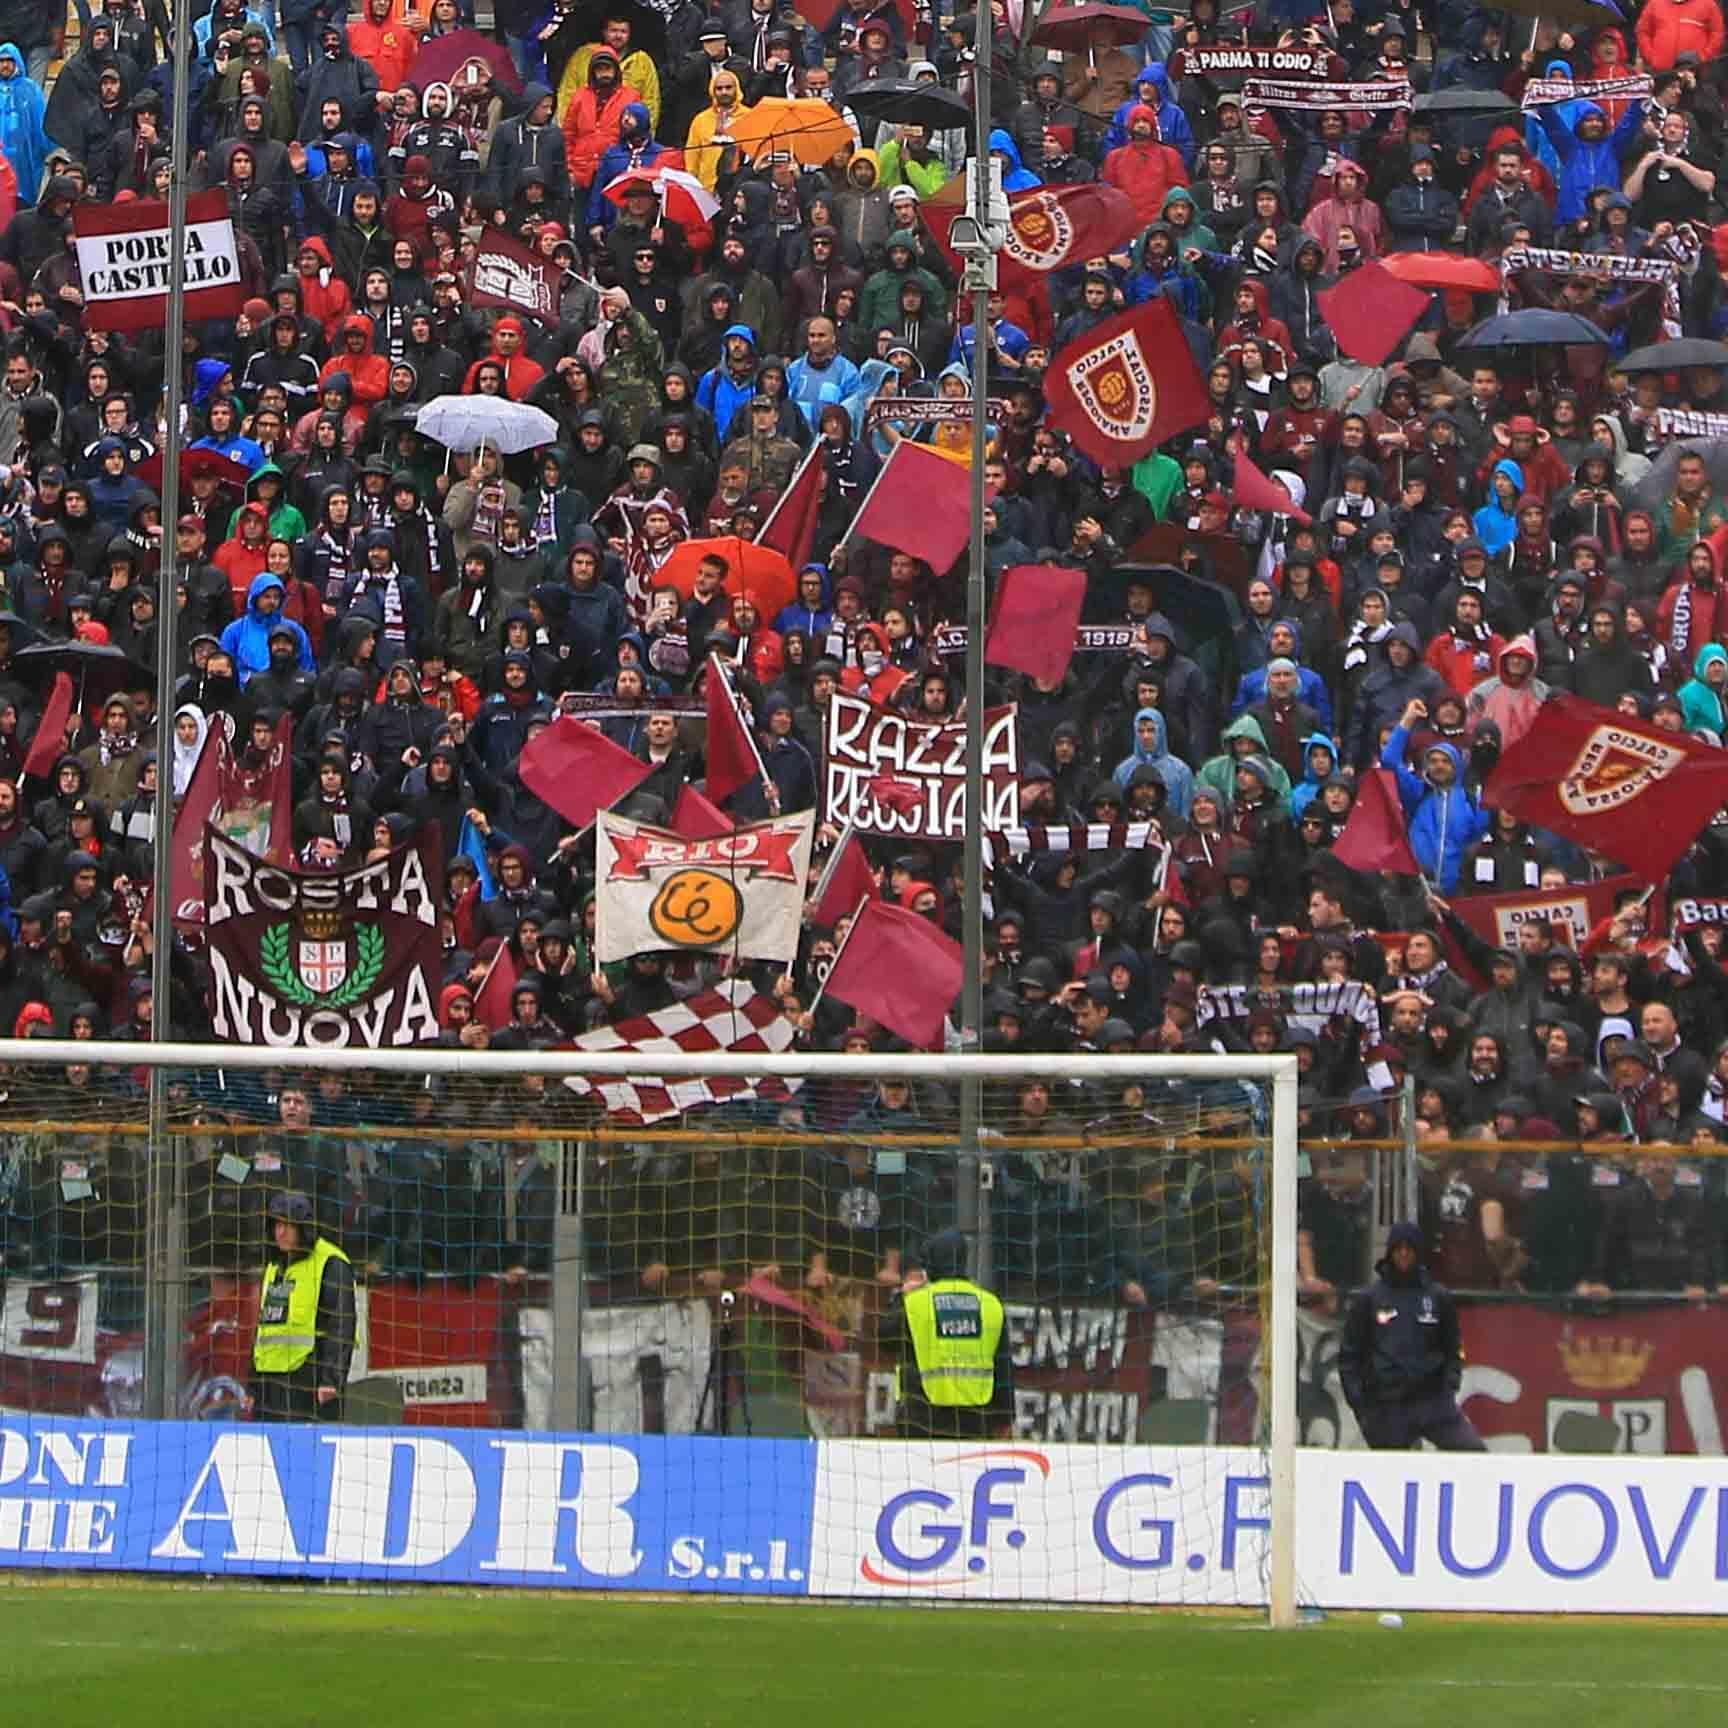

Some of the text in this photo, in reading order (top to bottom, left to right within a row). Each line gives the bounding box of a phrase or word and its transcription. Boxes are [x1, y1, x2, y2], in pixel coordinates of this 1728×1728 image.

[1200, 51, 1312, 72] PARMA TI ODIO
[1082, 630, 1130, 647] 1919
[831, 694, 1018, 775] RAZZA
[643, 831, 761, 860] RIO
[208, 848, 436, 927] ROSTA
[210, 946, 440, 1048] NUOVA
[151, 1433, 805, 1582] ADR S.r.l.
